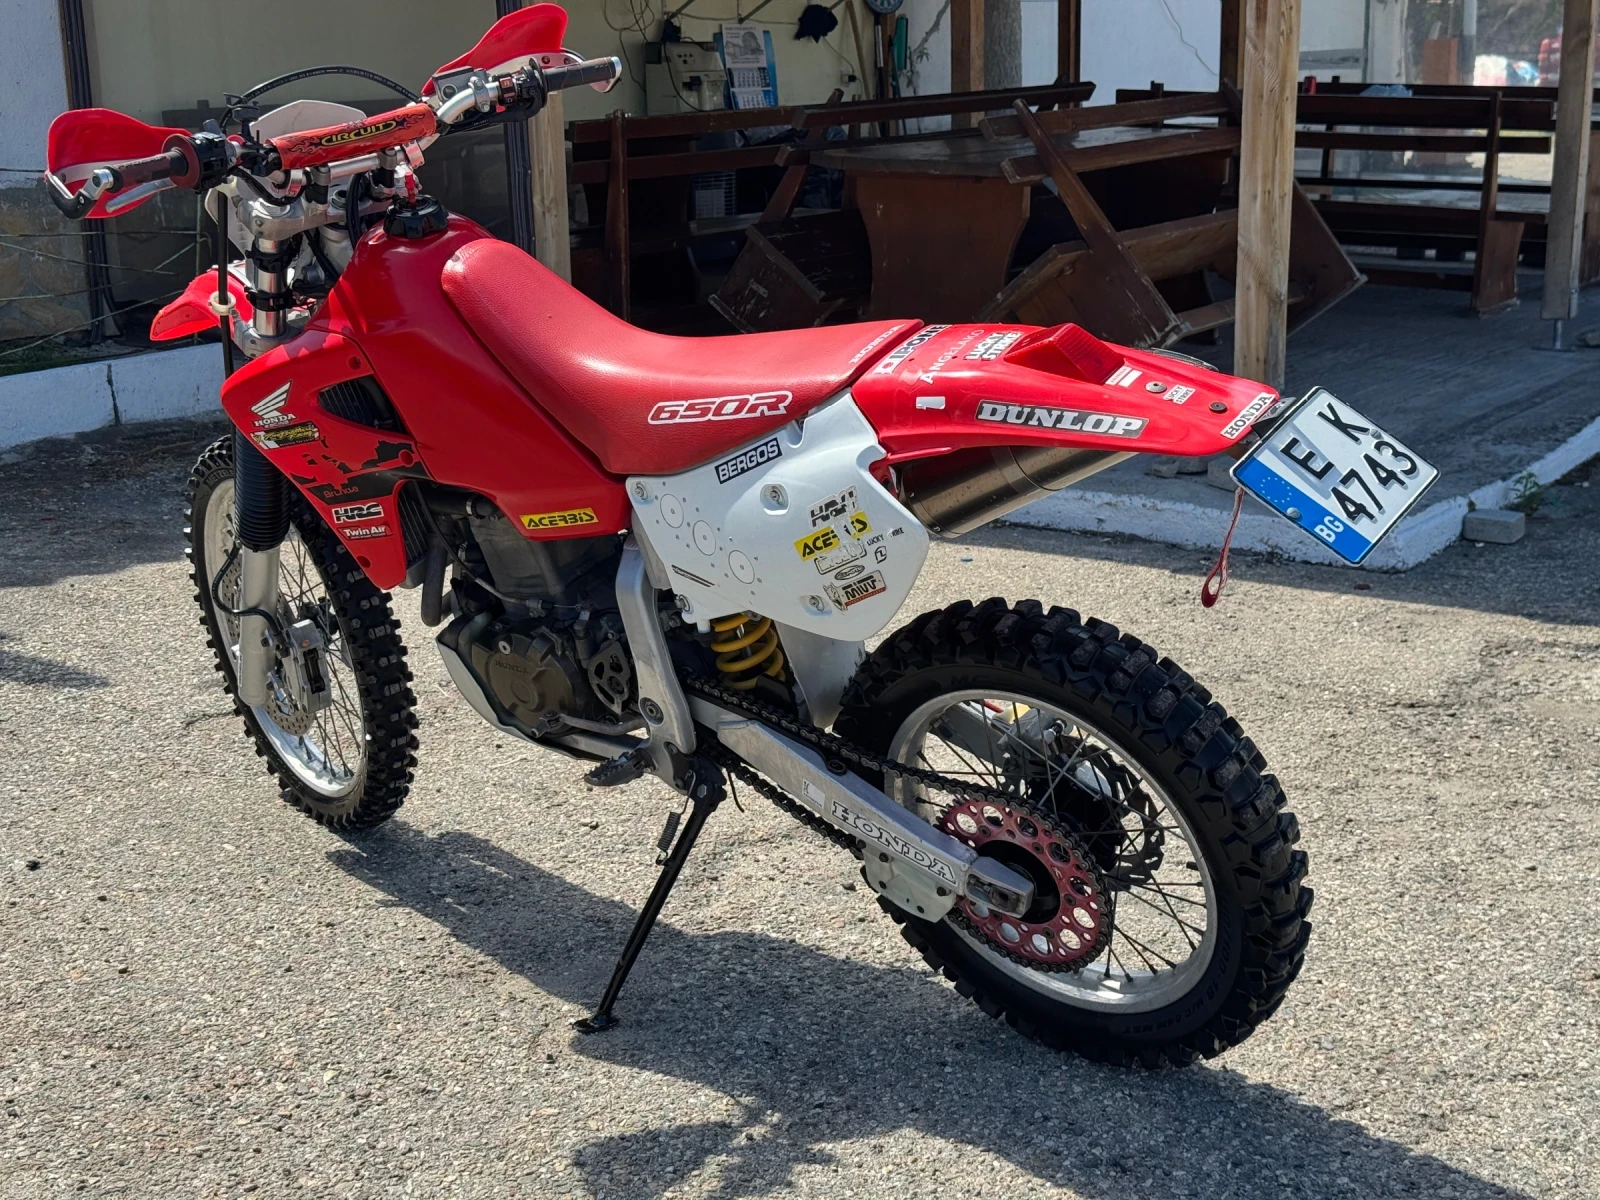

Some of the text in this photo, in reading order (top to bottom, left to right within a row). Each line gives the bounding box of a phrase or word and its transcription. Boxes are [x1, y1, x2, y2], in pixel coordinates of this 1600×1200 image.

[321, 120, 396, 146] CIRCUIT
[850, 324, 906, 363] HONDA
[965, 332, 1003, 360] LUCKY
[982, 331, 1022, 361] STRIKE
[253, 413, 296, 427] HONDA
[648, 391, 793, 424] 650R
[977, 403, 1144, 435] DUNLOP
[1224, 394, 1272, 437] HONDA
[1279, 437, 1334, 480] E
[1317, 402, 1370, 443] K
[718, 441, 779, 481] BERGOS
[1331, 440, 1417, 521] 4743
[332, 503, 385, 523] HRC
[344, 527, 370, 537] Twin
[371, 525, 386, 534] Air
[866, 534, 885, 547] LUCKY
[1314, 516, 1344, 543] BG
[832, 800, 957, 886] HONDA
